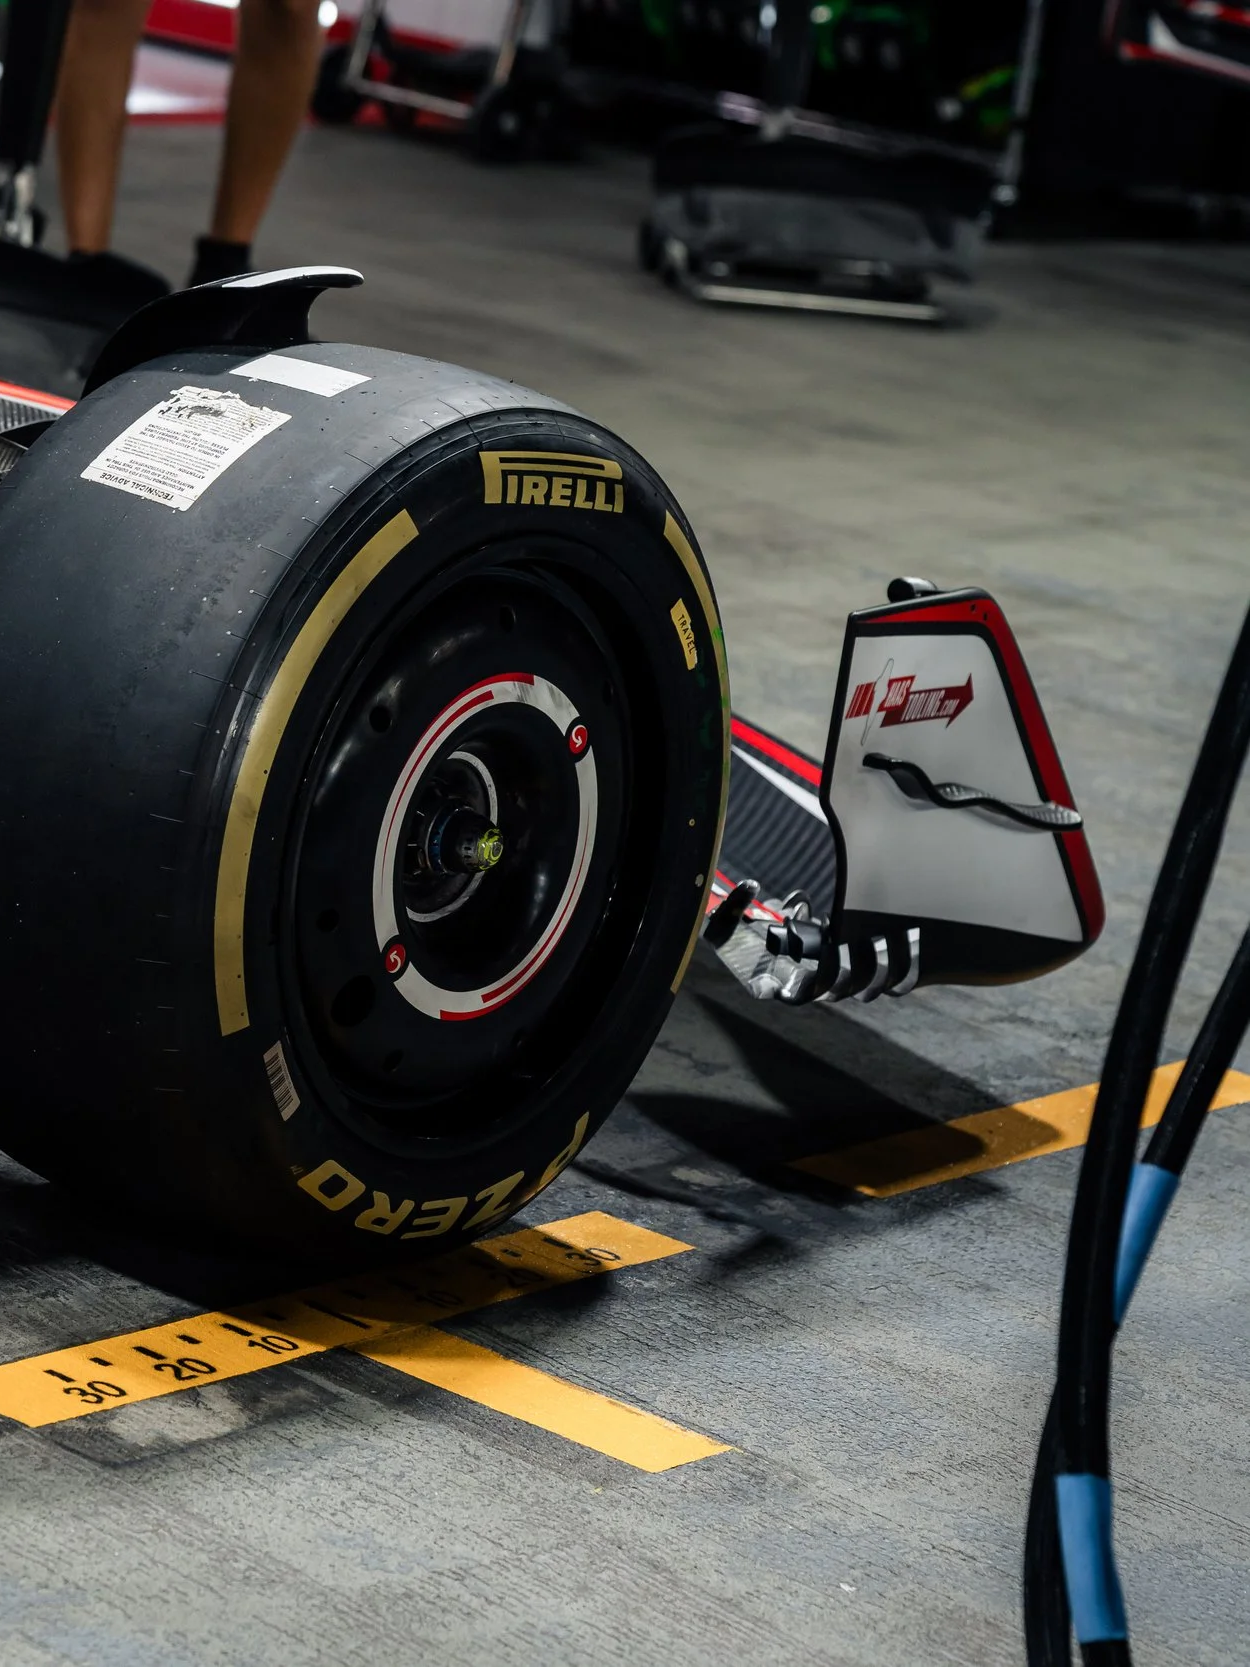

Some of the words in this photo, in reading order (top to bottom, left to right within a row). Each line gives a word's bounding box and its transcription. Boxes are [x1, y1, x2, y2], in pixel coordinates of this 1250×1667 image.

[100, 472, 130, 486] ADVICE
[131, 480, 174, 501] TECHNICAL
[478, 451, 625, 514] PIRELLI
[677, 613, 697, 655] TRAVEL
[297, 1159, 525, 1240] ZERO
[63, 1379, 128, 1405] 30
[153, 1356, 218, 1382] 20
[248, 1334, 300, 1355] 10
[488, 1265, 545, 1289] 20
[565, 1246, 622, 1275] 30
